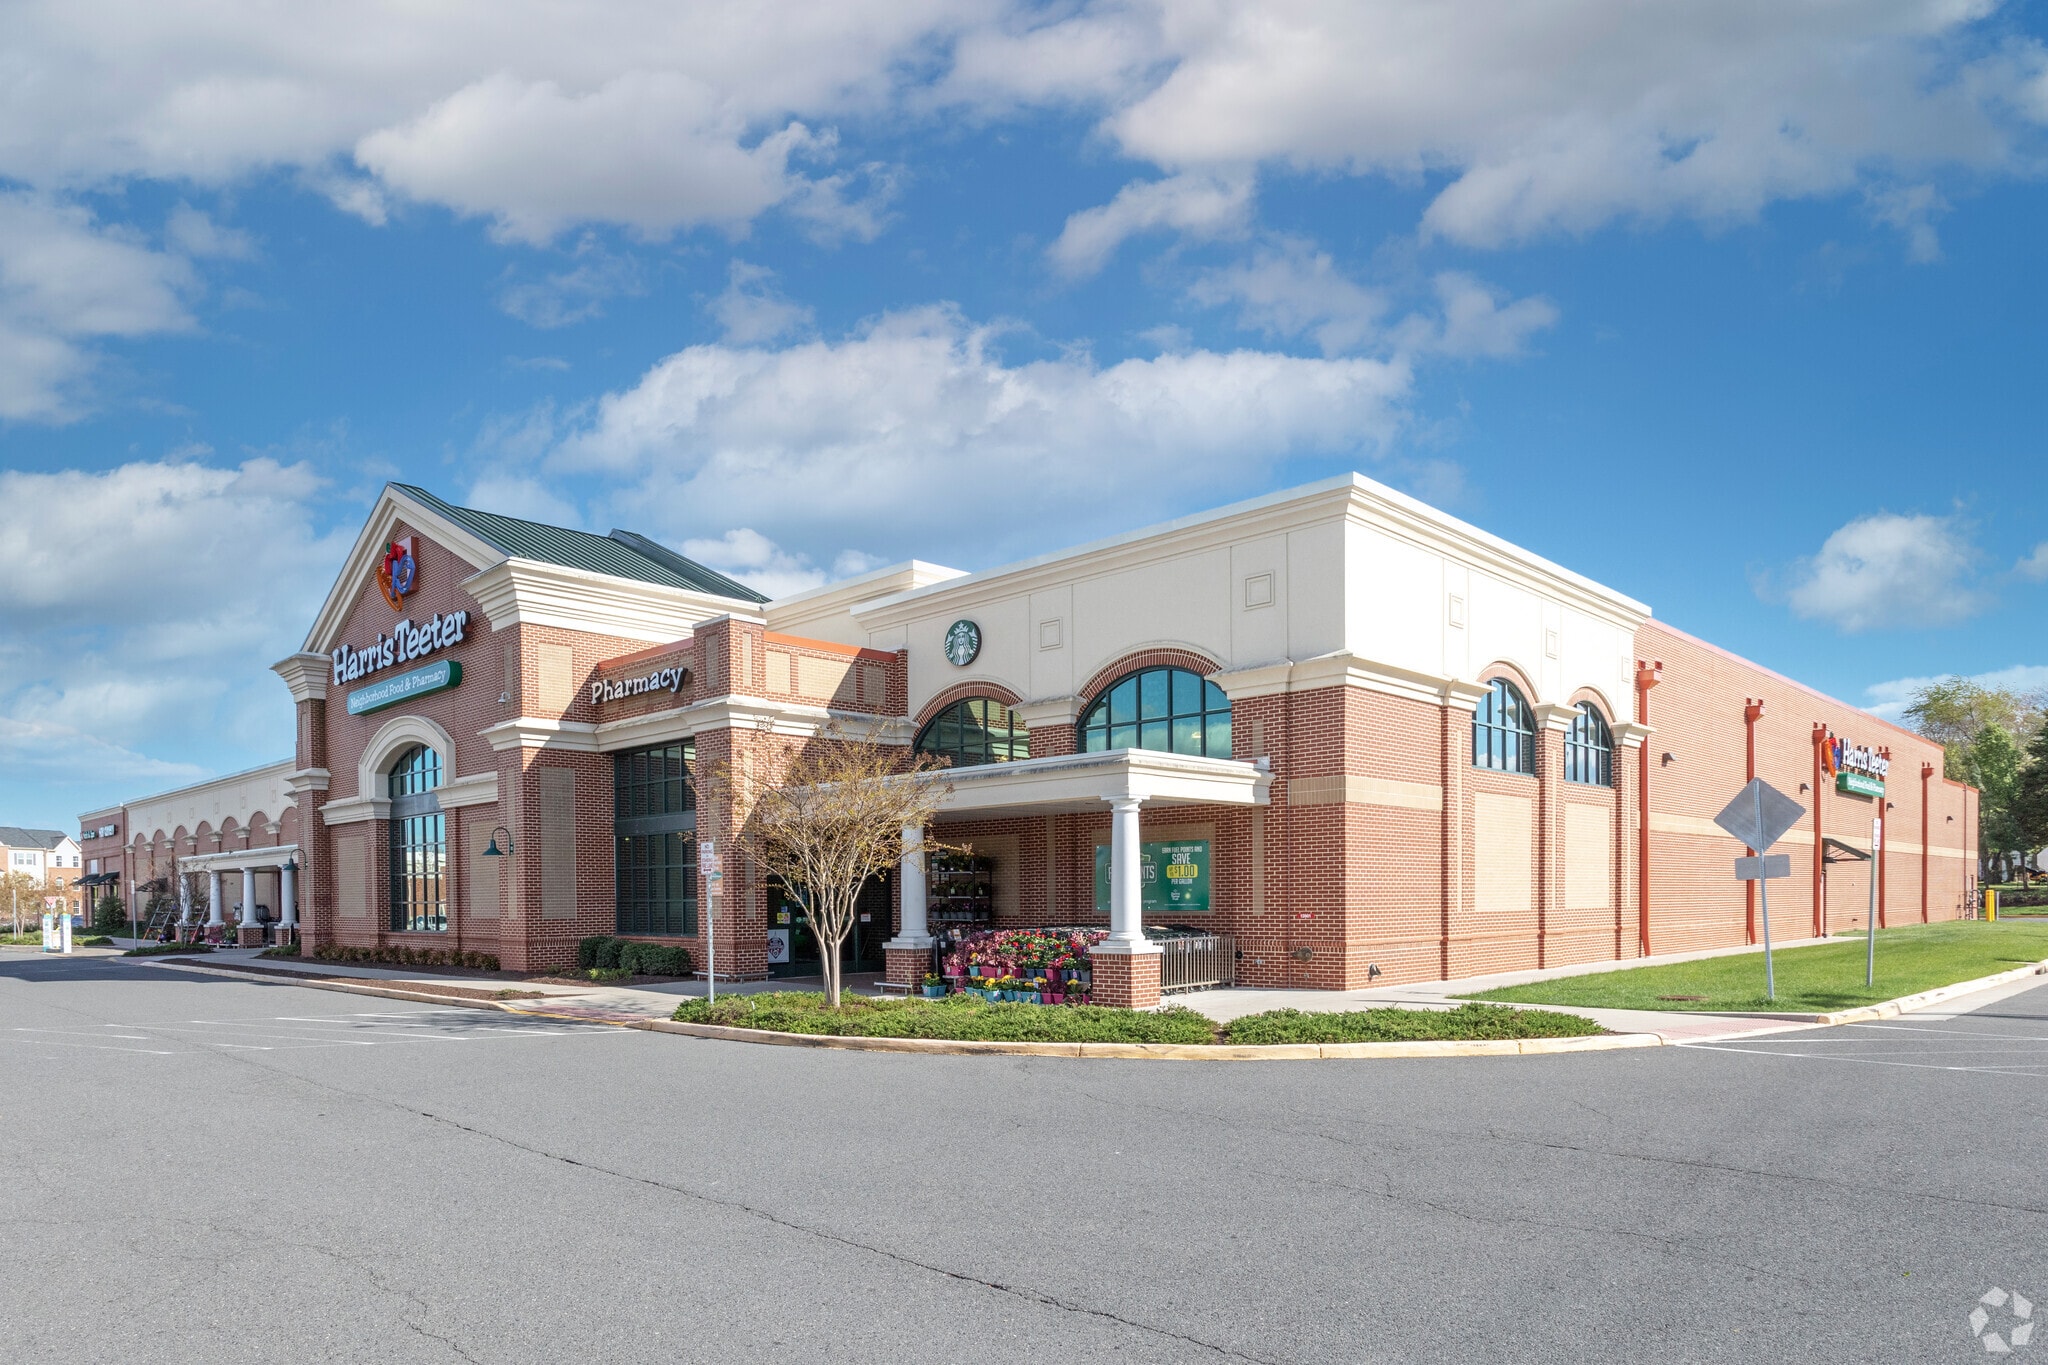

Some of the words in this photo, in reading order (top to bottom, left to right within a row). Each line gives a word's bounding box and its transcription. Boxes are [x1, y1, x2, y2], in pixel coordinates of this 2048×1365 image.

[332, 633, 394, 686] Harris
[395, 610, 467, 662] Teeter
[350, 686, 389, 709] Neighborhood
[389, 680, 404, 696] Food
[404, 678, 412, 691] &
[412, 669, 446, 689] Pharmacy
[591, 667, 684, 704] Pharmacy
[1842, 738, 1868, 771] Harris
[1868, 746, 1889, 777] Teeter
[1171, 853, 1191, 864] SAVE
[1174, 865, 1195, 877] $1.00
